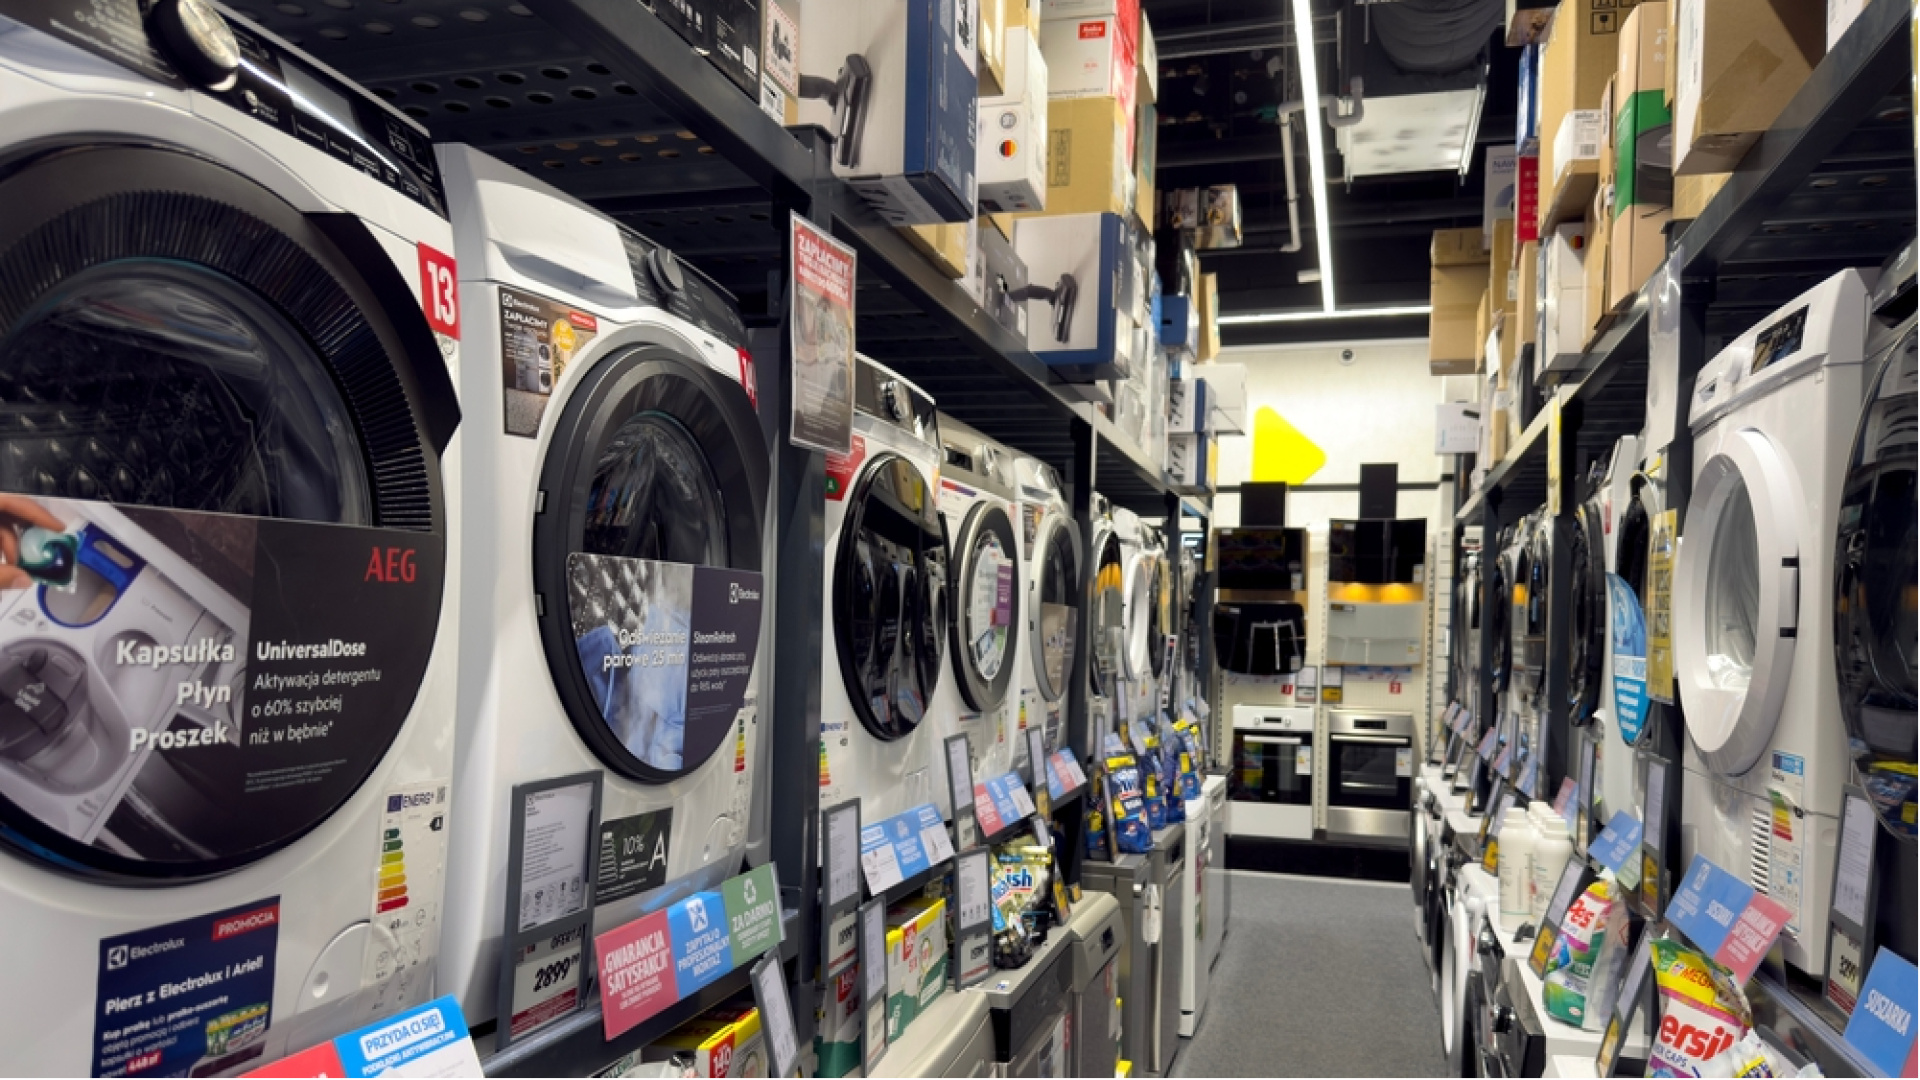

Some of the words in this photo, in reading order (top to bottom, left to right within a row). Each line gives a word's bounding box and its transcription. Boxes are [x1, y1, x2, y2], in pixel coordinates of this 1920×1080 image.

[427, 261, 456, 325] 13
[364, 547, 416, 583] AEG
[256, 638, 367, 661] UniversalDose
[618, 629, 686, 646] Odświeżanie
[116, 638, 235, 670] Kapsułka
[177, 680, 231, 709] Płyn
[253, 672, 319, 692] Aktywacja
[321, 668, 382, 687] detergentu
[252, 706, 260, 718] o
[264, 699, 292, 716] 60%
[295, 695, 343, 715] szybciej
[129, 719, 228, 752] Proszek
[249, 727, 269, 745] niż
[273, 730, 284, 742] w
[648, 830, 667, 871] A
[218, 911, 275, 936] PROMOCJA
[732, 913, 743, 932] ZA
[130, 937, 185, 960] Electrolux
[105, 993, 143, 1015] Pierz
[146, 991, 156, 1003] z
[159, 970, 223, 999] Electrolux
[1863, 987, 1912, 1037] SUSZARKA
[364, 1024, 409, 1054] PRZYDA
[1660, 1014, 1735, 1061] ersil
